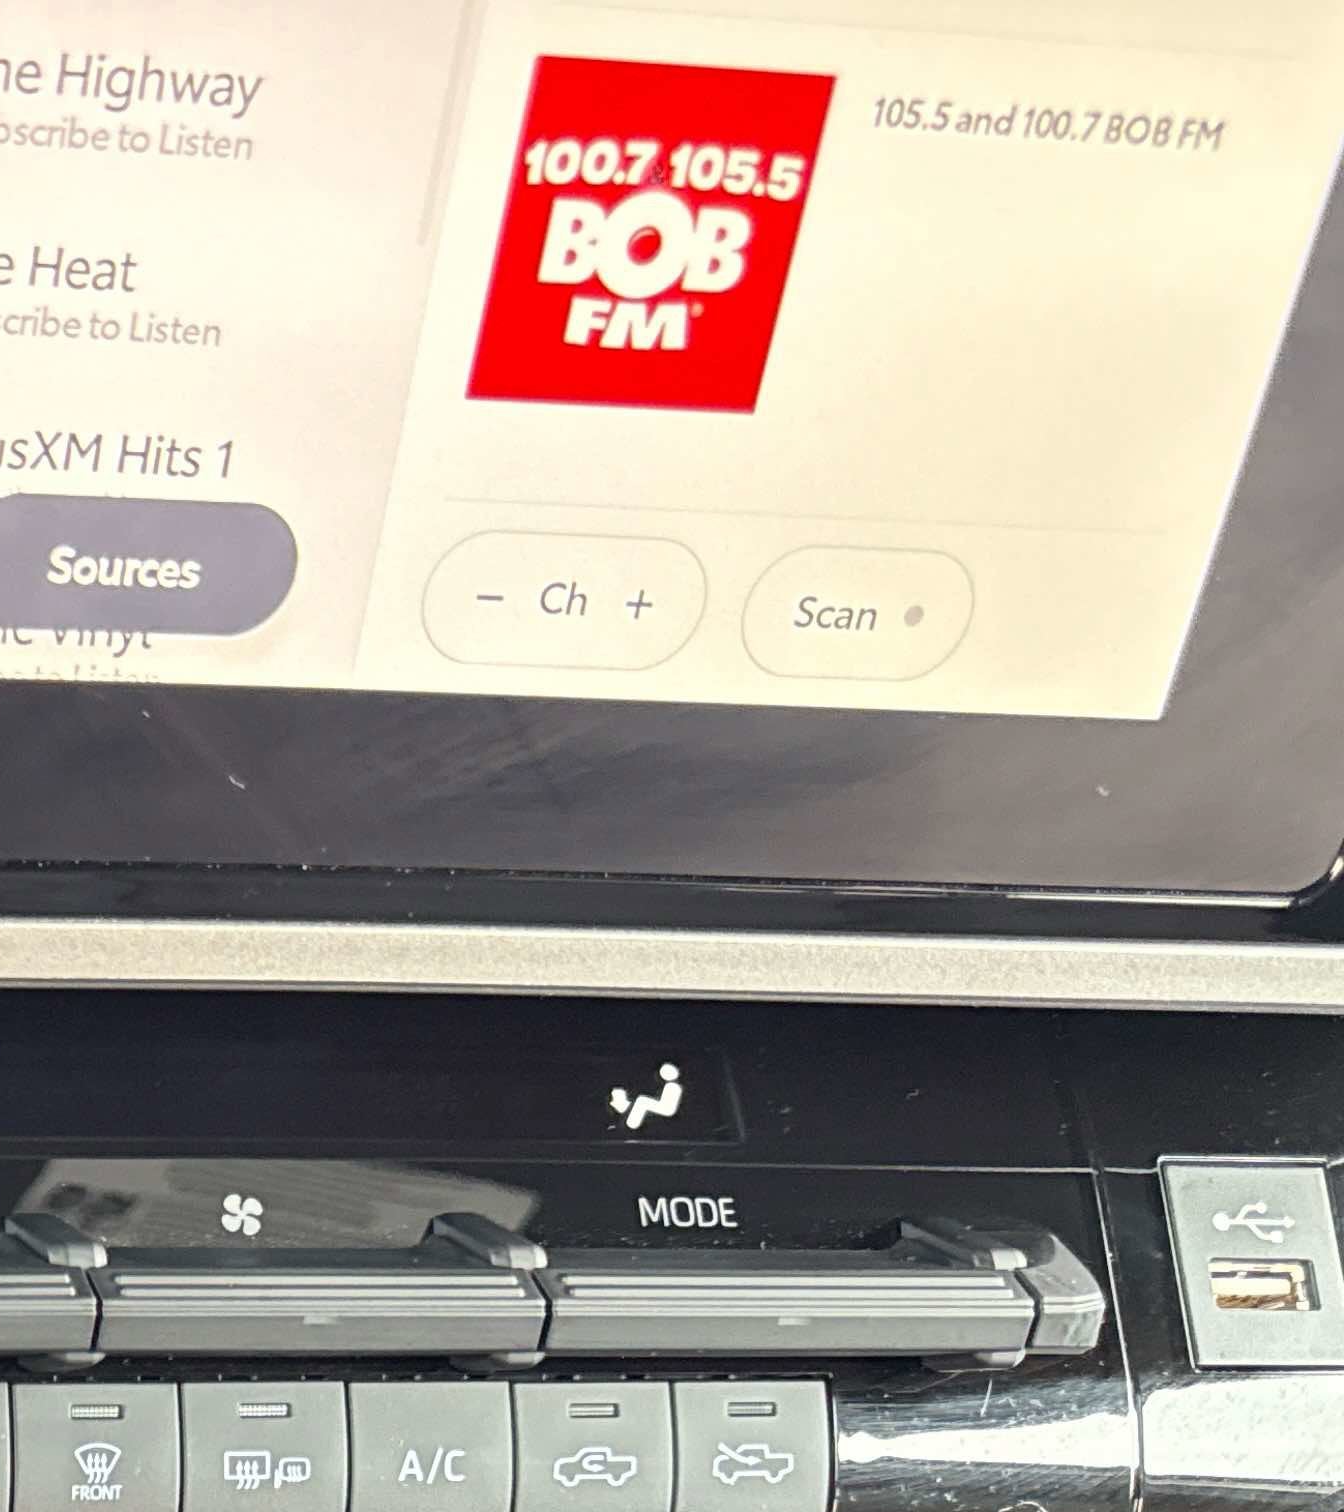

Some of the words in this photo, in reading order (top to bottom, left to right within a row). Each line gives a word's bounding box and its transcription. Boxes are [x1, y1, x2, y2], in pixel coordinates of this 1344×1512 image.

[57, 54, 262, 119] Highway
[118, 117, 149, 153] to
[158, 124, 253, 160] Listen
[873, 97, 953, 132] 105.5
[955, 104, 1017, 136] and
[1023, 108, 1100, 142] 100.7
[1103, 115, 1173, 148] BOB
[1176, 117, 1226, 152] FM
[524, 137, 660, 186] 100.7
[670, 142, 806, 201] 105.5
[537, 191, 751, 299] BOB
[29, 245, 137, 293] Heat
[89, 307, 120, 341] to
[129, 313, 222, 347] Listen
[563, 296, 688, 352] FM
[117, 434, 202, 478] Hits
[217, 440, 233, 479] 1
[47, 546, 201, 588] Sources
[539, 581, 587, 617] Ch
[793, 594, 877, 632] Scan
[638, 1197, 738, 1228] MODE
[398, 1447, 467, 1485] A/C
[71, 1484, 122, 1501] FRONT
